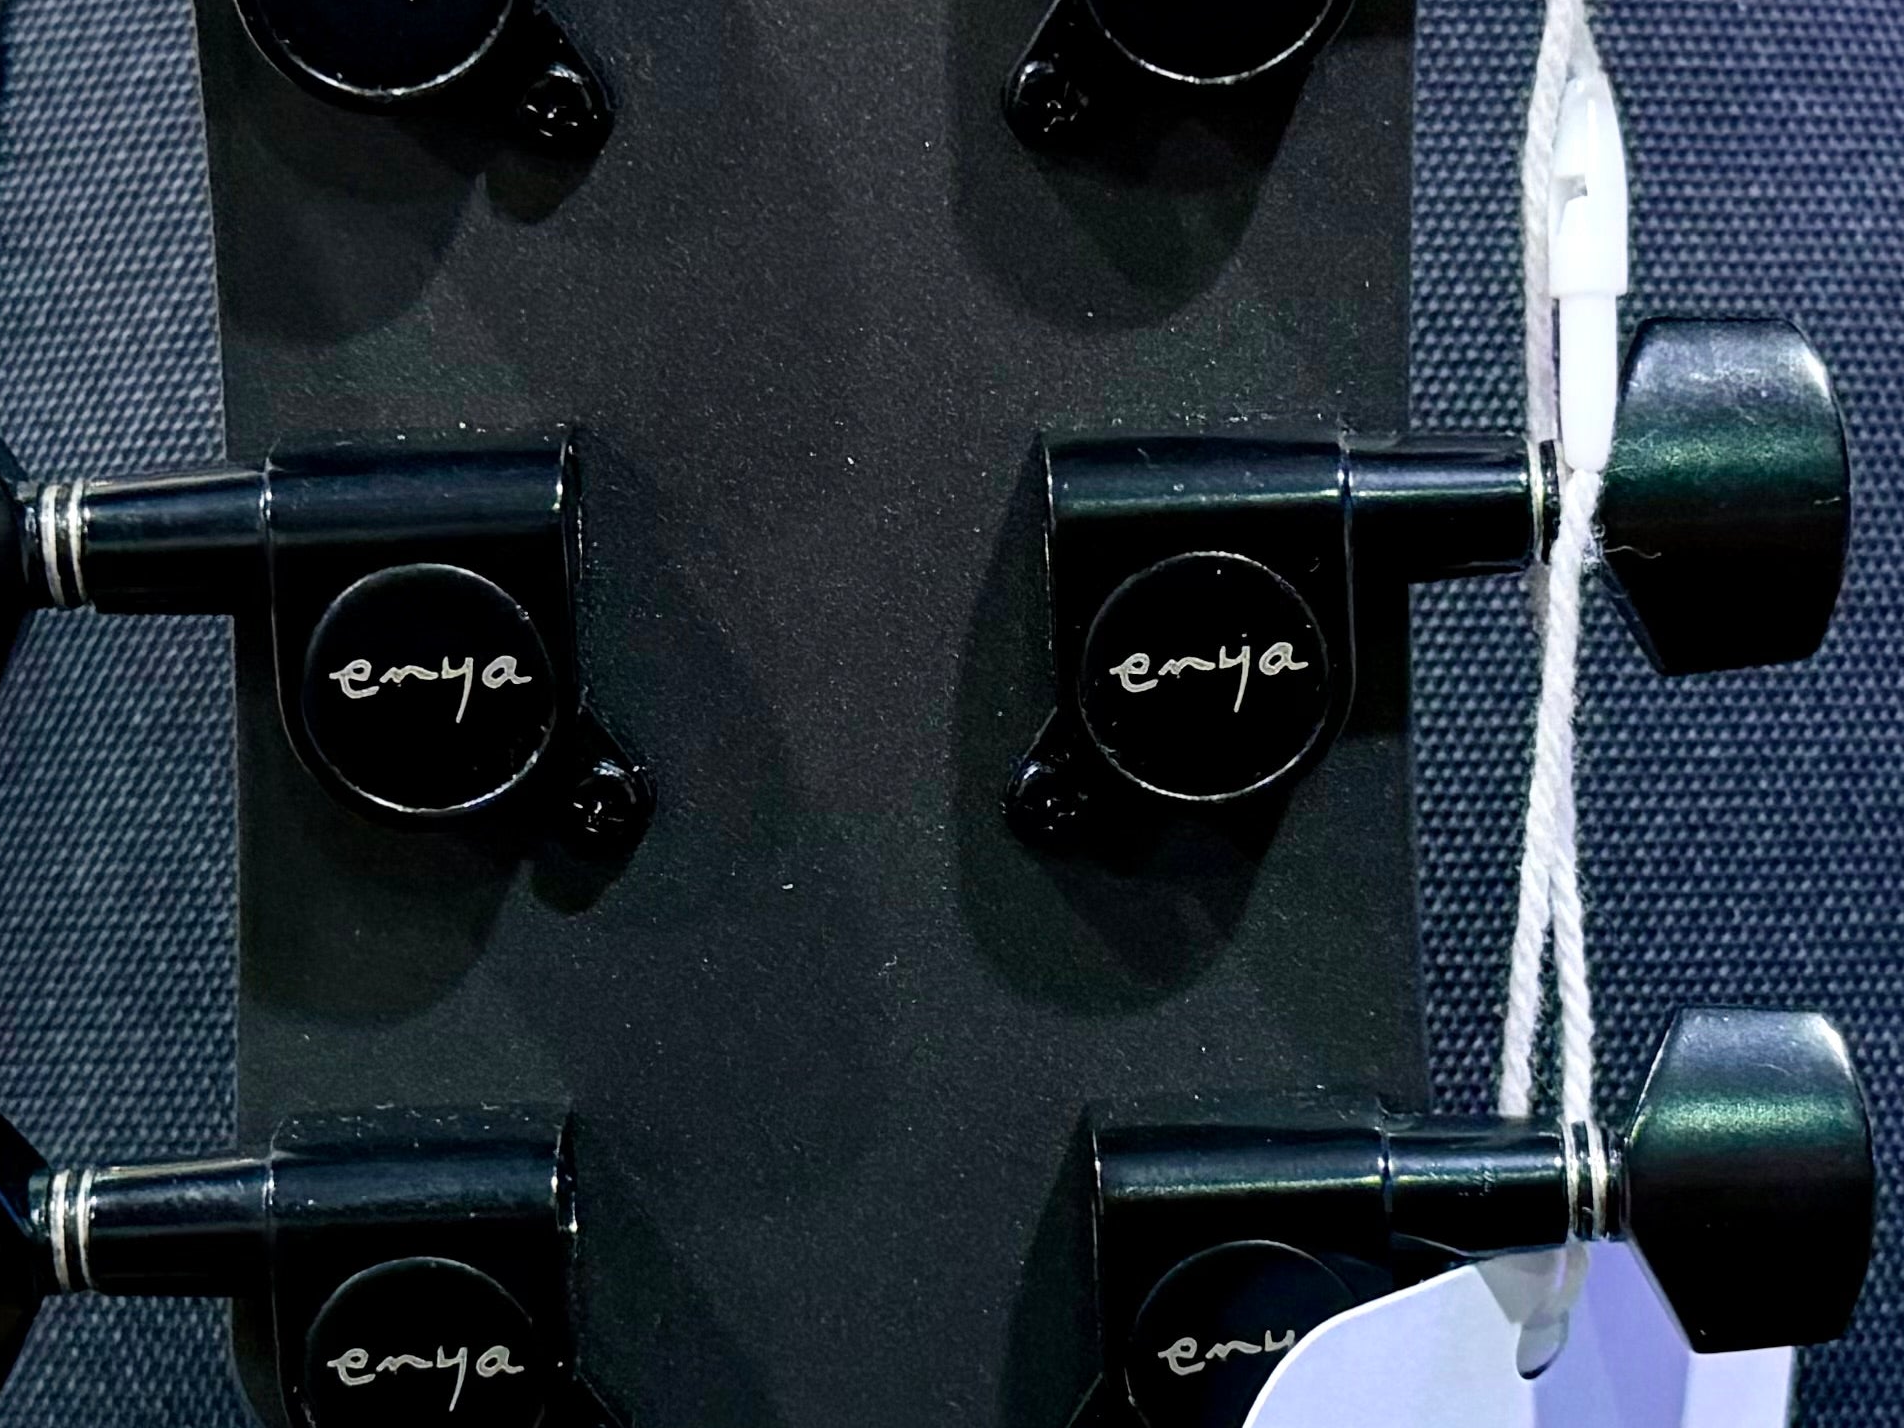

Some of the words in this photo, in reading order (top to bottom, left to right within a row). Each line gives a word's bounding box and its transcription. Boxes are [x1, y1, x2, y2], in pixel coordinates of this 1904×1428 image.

[327, 654, 534, 724] enya
[1107, 640, 1310, 714] enya
[326, 1344, 526, 1412] enya
[1157, 1329, 1296, 1376] eny
